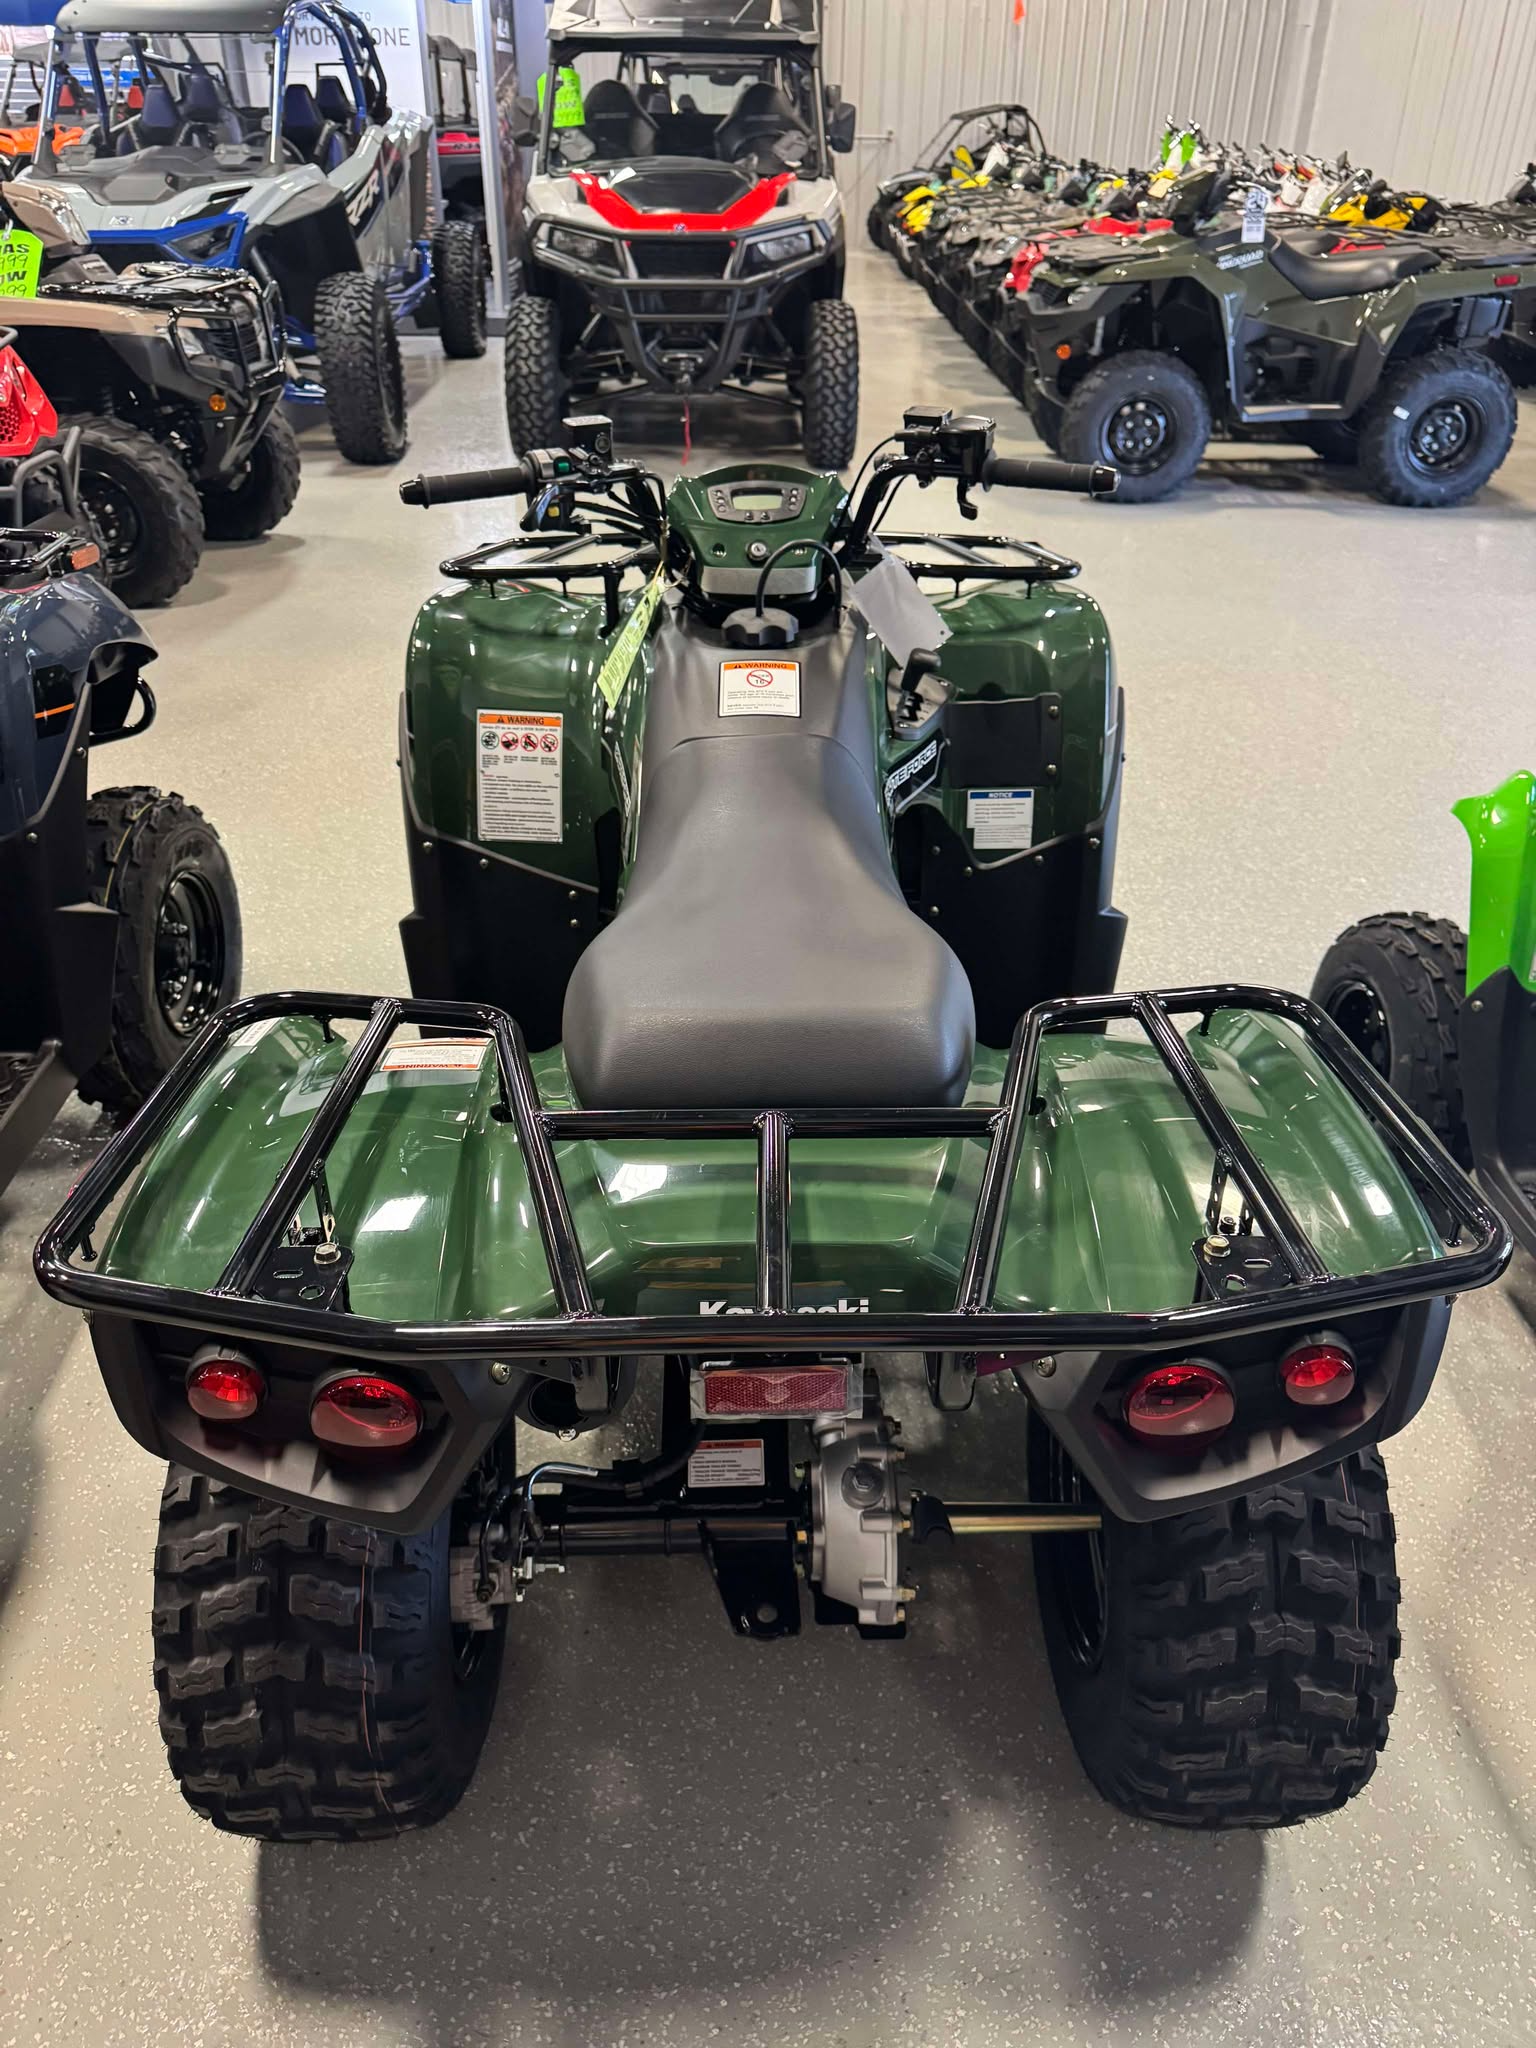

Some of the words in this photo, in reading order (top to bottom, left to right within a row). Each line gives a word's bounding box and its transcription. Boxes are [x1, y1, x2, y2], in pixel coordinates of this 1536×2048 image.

[295, 27, 337, 46] MOR
[0, 244, 30, 254] AS
[507, 715, 544, 725] WARNING
